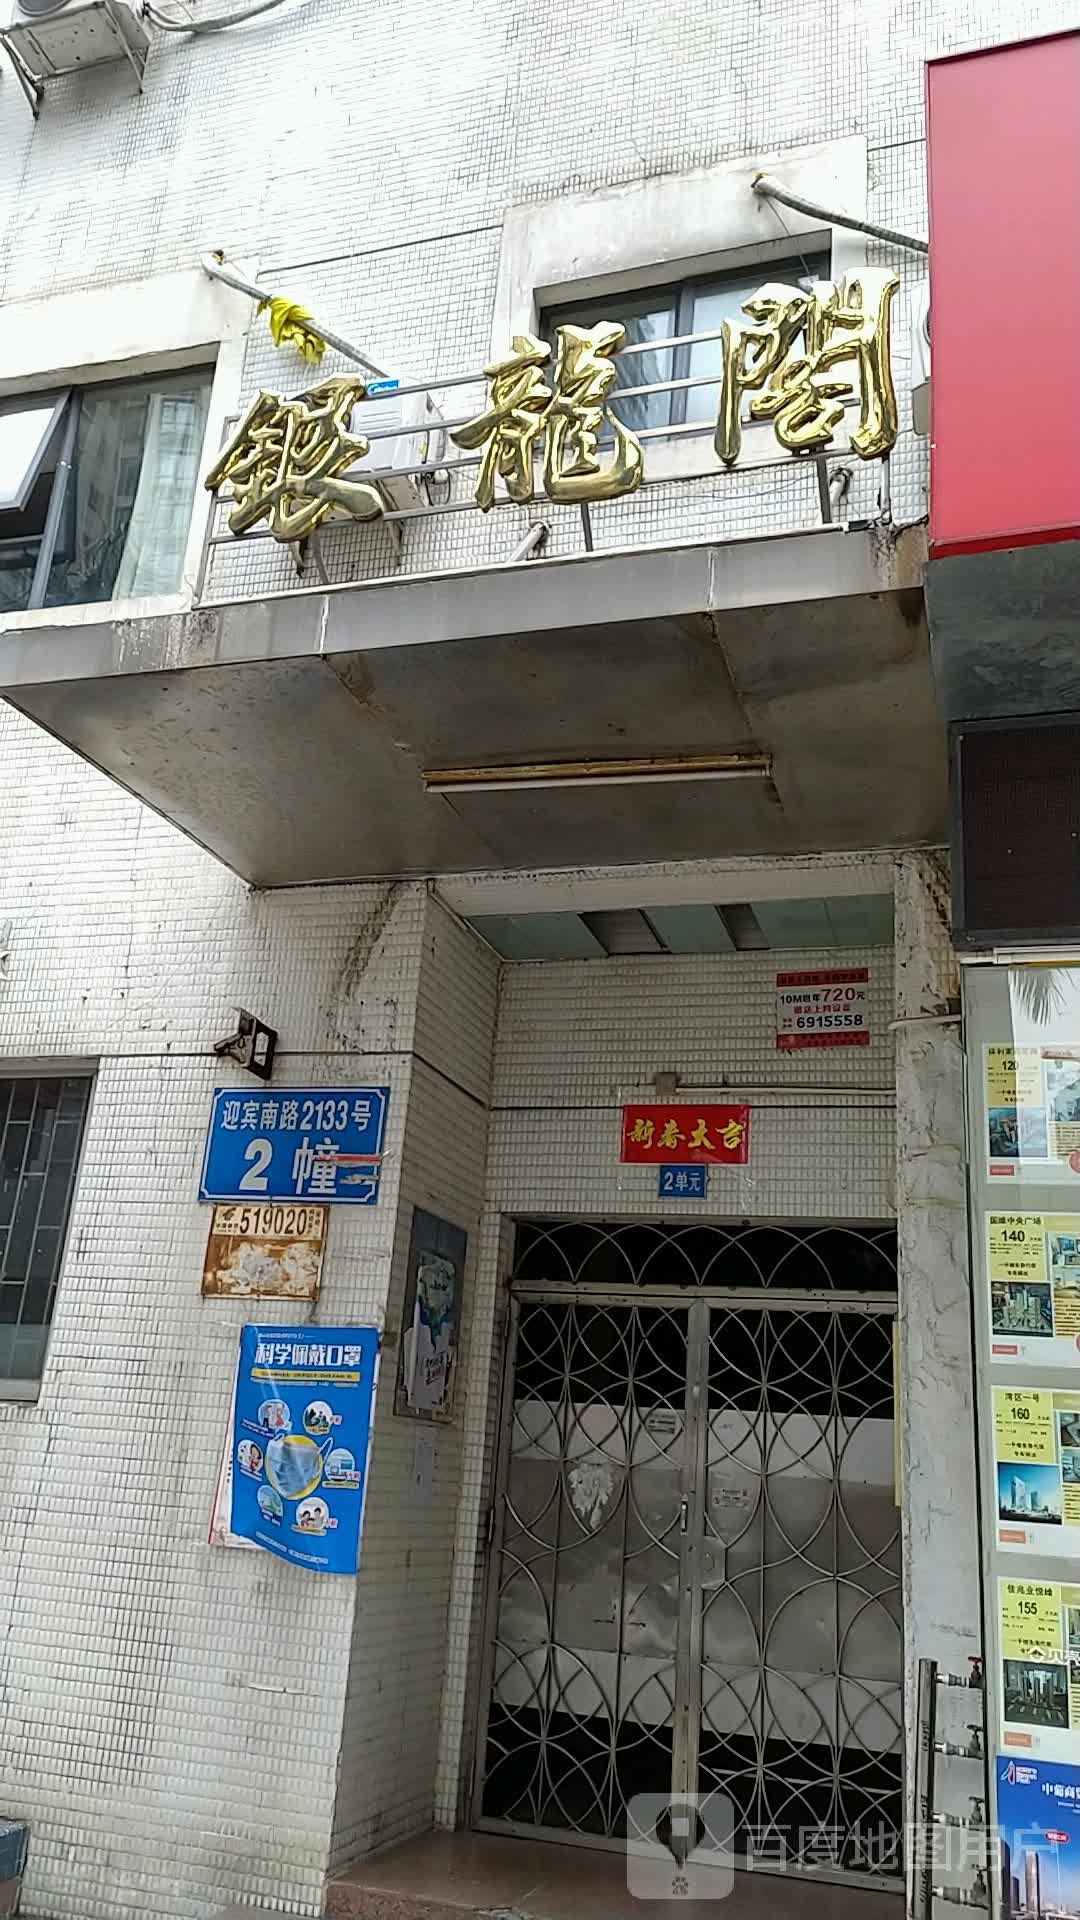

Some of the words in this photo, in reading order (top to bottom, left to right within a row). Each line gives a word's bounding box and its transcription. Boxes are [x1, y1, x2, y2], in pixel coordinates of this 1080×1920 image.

[797, 1015, 863, 1028] 6915558
[221, 1100, 371, 1132] 迎宾南路2133号
[627, 1118, 744, 1150] 新春大吉
[664, 1172, 701, 1192] 2单元
[240, 1208, 307, 1235] 519020
[1001, 1230, 1025, 1242] 140
[255, 1343, 362, 1367] 科学佩戴口罩
[1011, 1408, 1030, 1420] 160
[1018, 1601, 1038, 1615] 155
